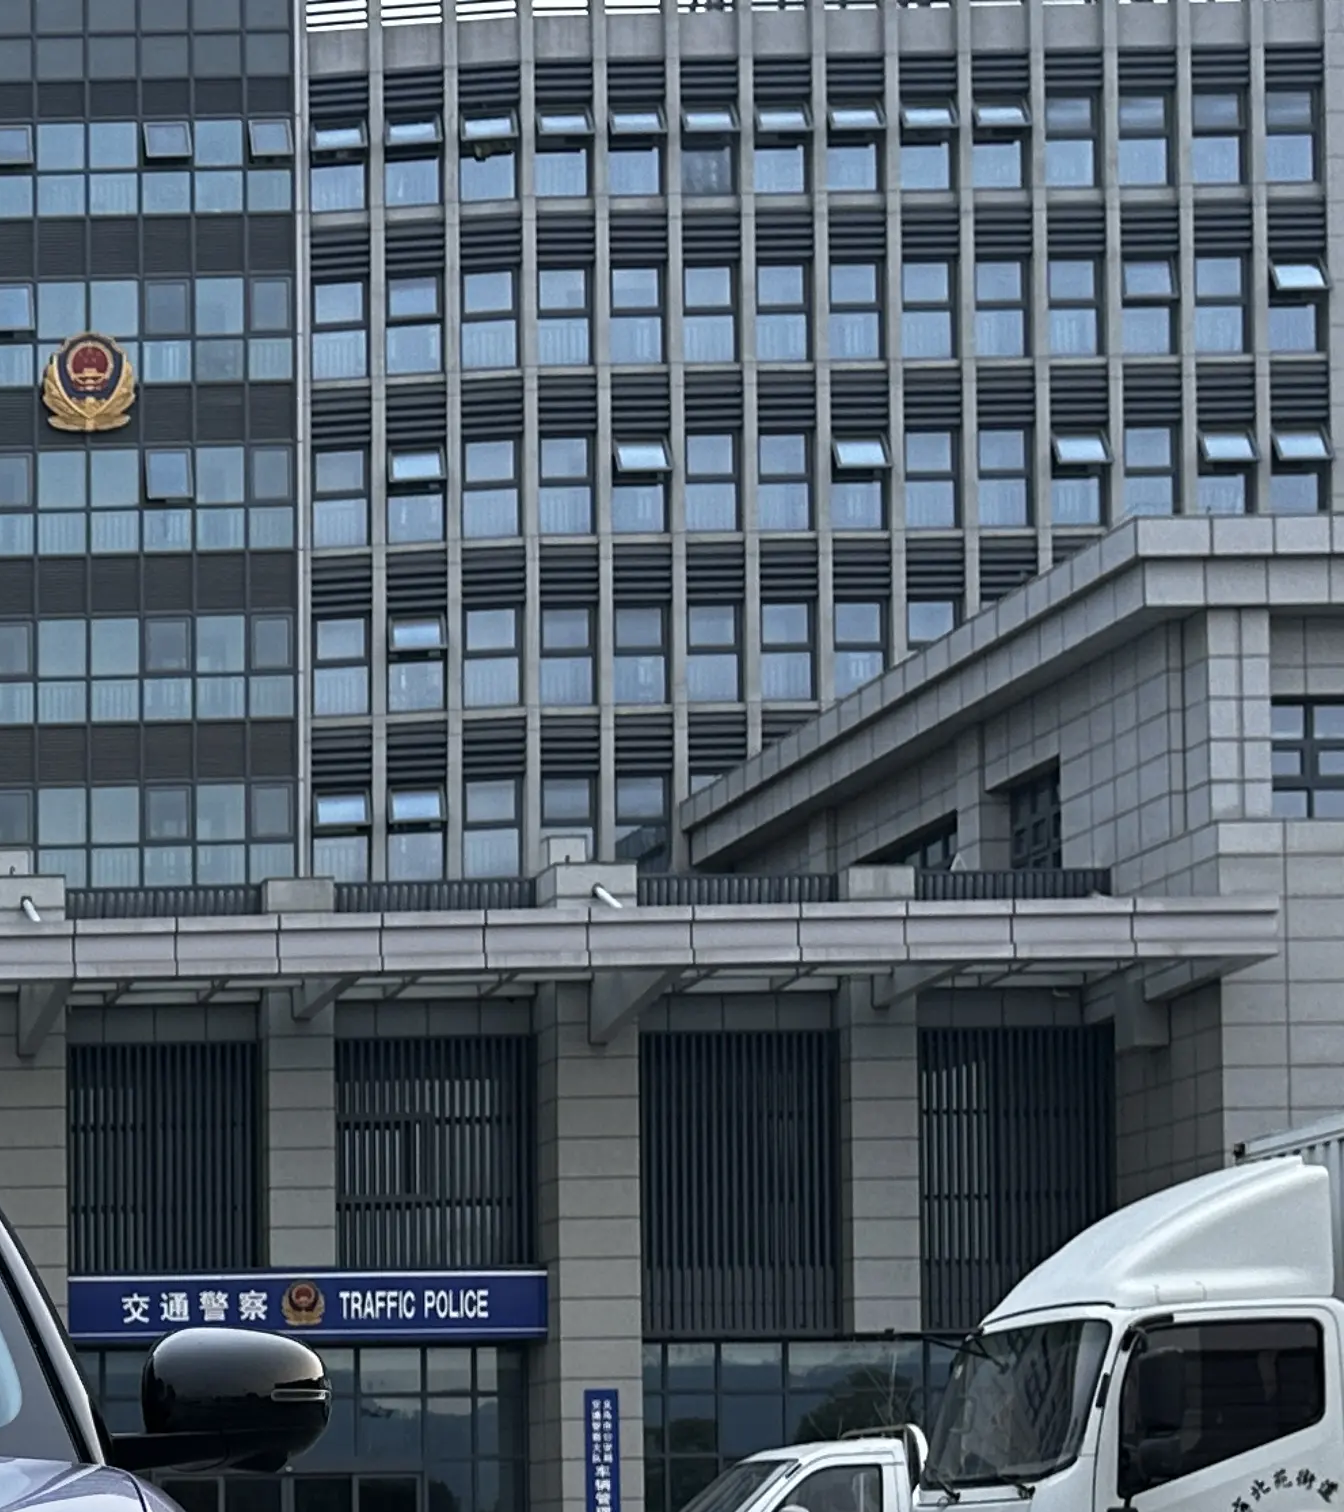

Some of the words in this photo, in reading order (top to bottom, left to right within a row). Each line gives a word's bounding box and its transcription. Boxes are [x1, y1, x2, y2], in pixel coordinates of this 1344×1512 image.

[122, 1290, 268, 1324] 交通警察
[339, 1290, 415, 1319] TRAFFIC
[424, 1289, 489, 1318] POLICE
